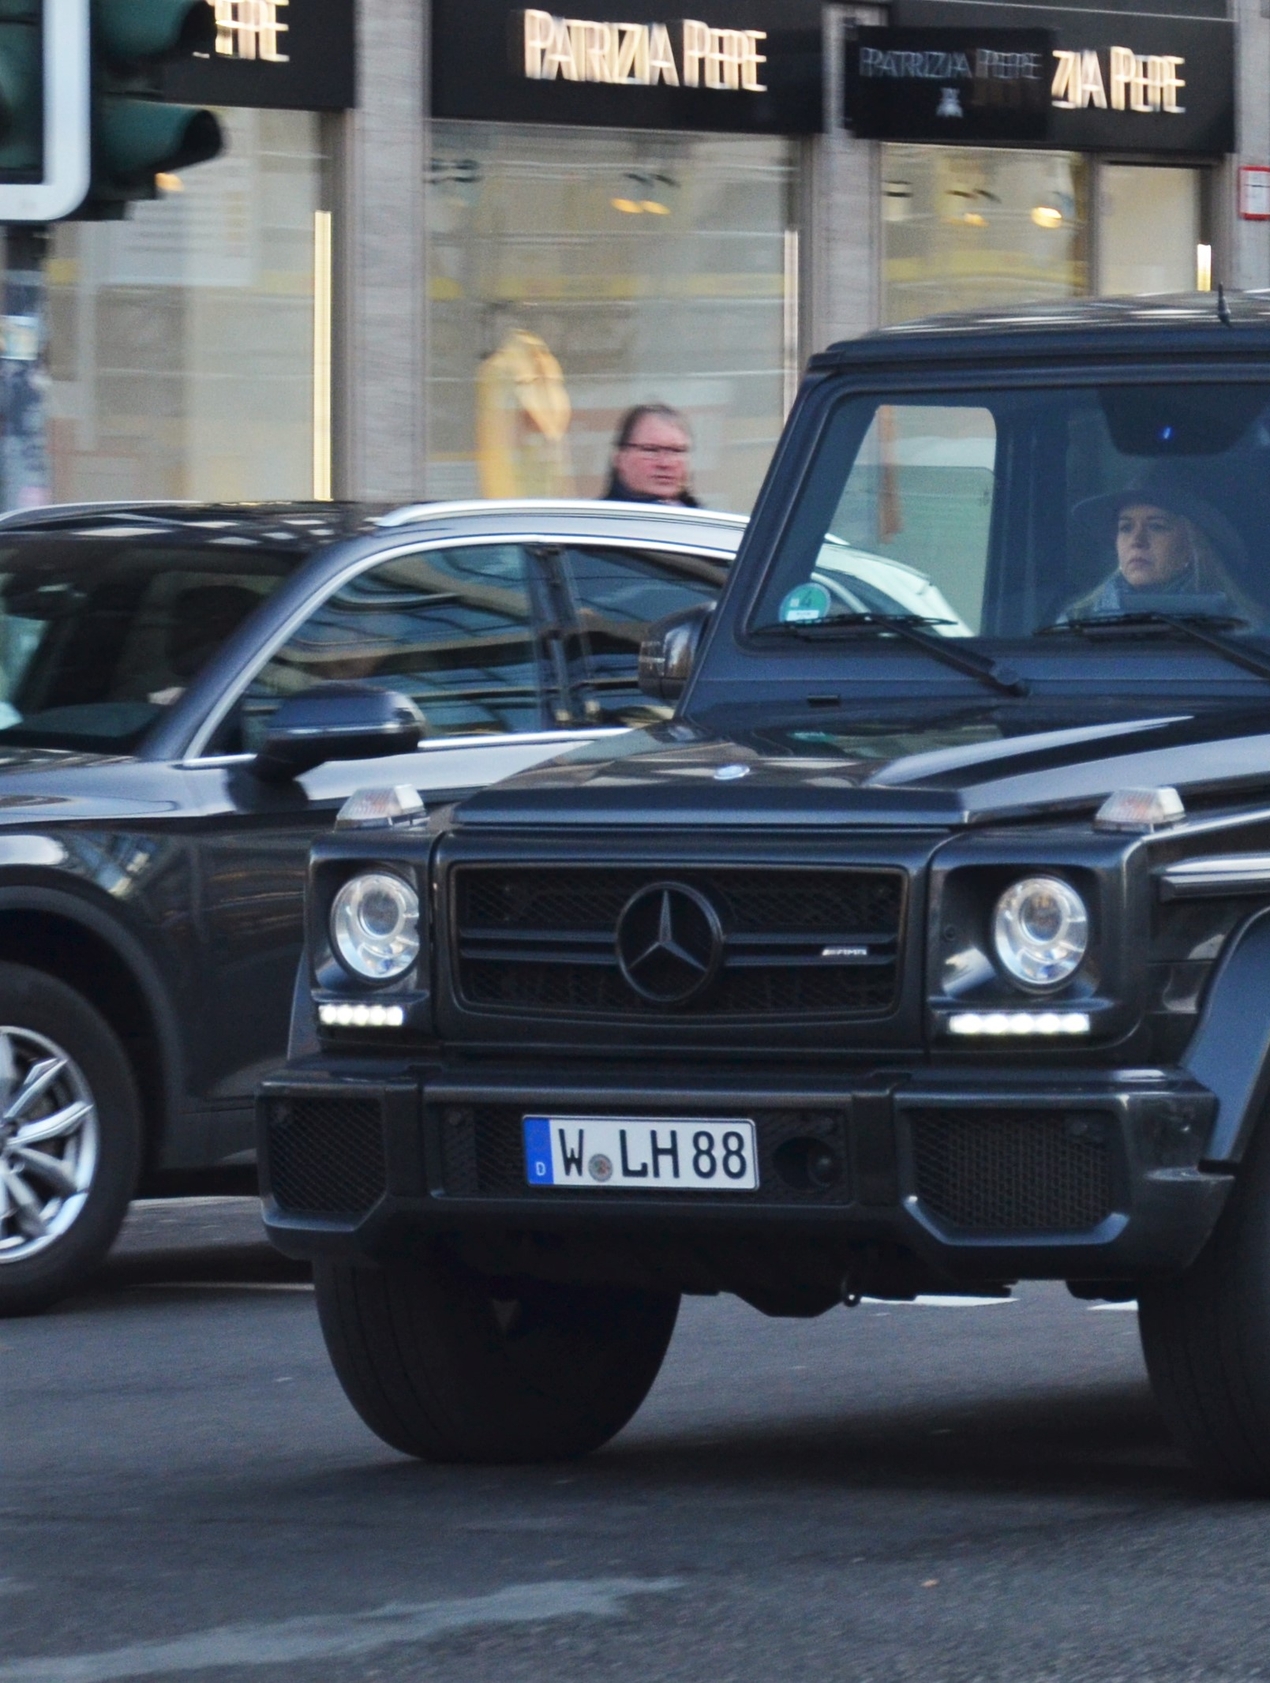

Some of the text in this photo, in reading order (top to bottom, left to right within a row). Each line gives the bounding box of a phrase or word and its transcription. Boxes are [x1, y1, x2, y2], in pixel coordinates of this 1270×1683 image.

[193, 0, 290, 62] EPE
[524, 8, 767, 92] PATRIZIA PEPE
[858, 47, 1043, 80] PATRIZIA PEPE
[1050, 45, 1186, 113] ZIA PEPE
[535, 1161, 546, 1176] D
[558, 1128, 747, 1179] W LH 88
